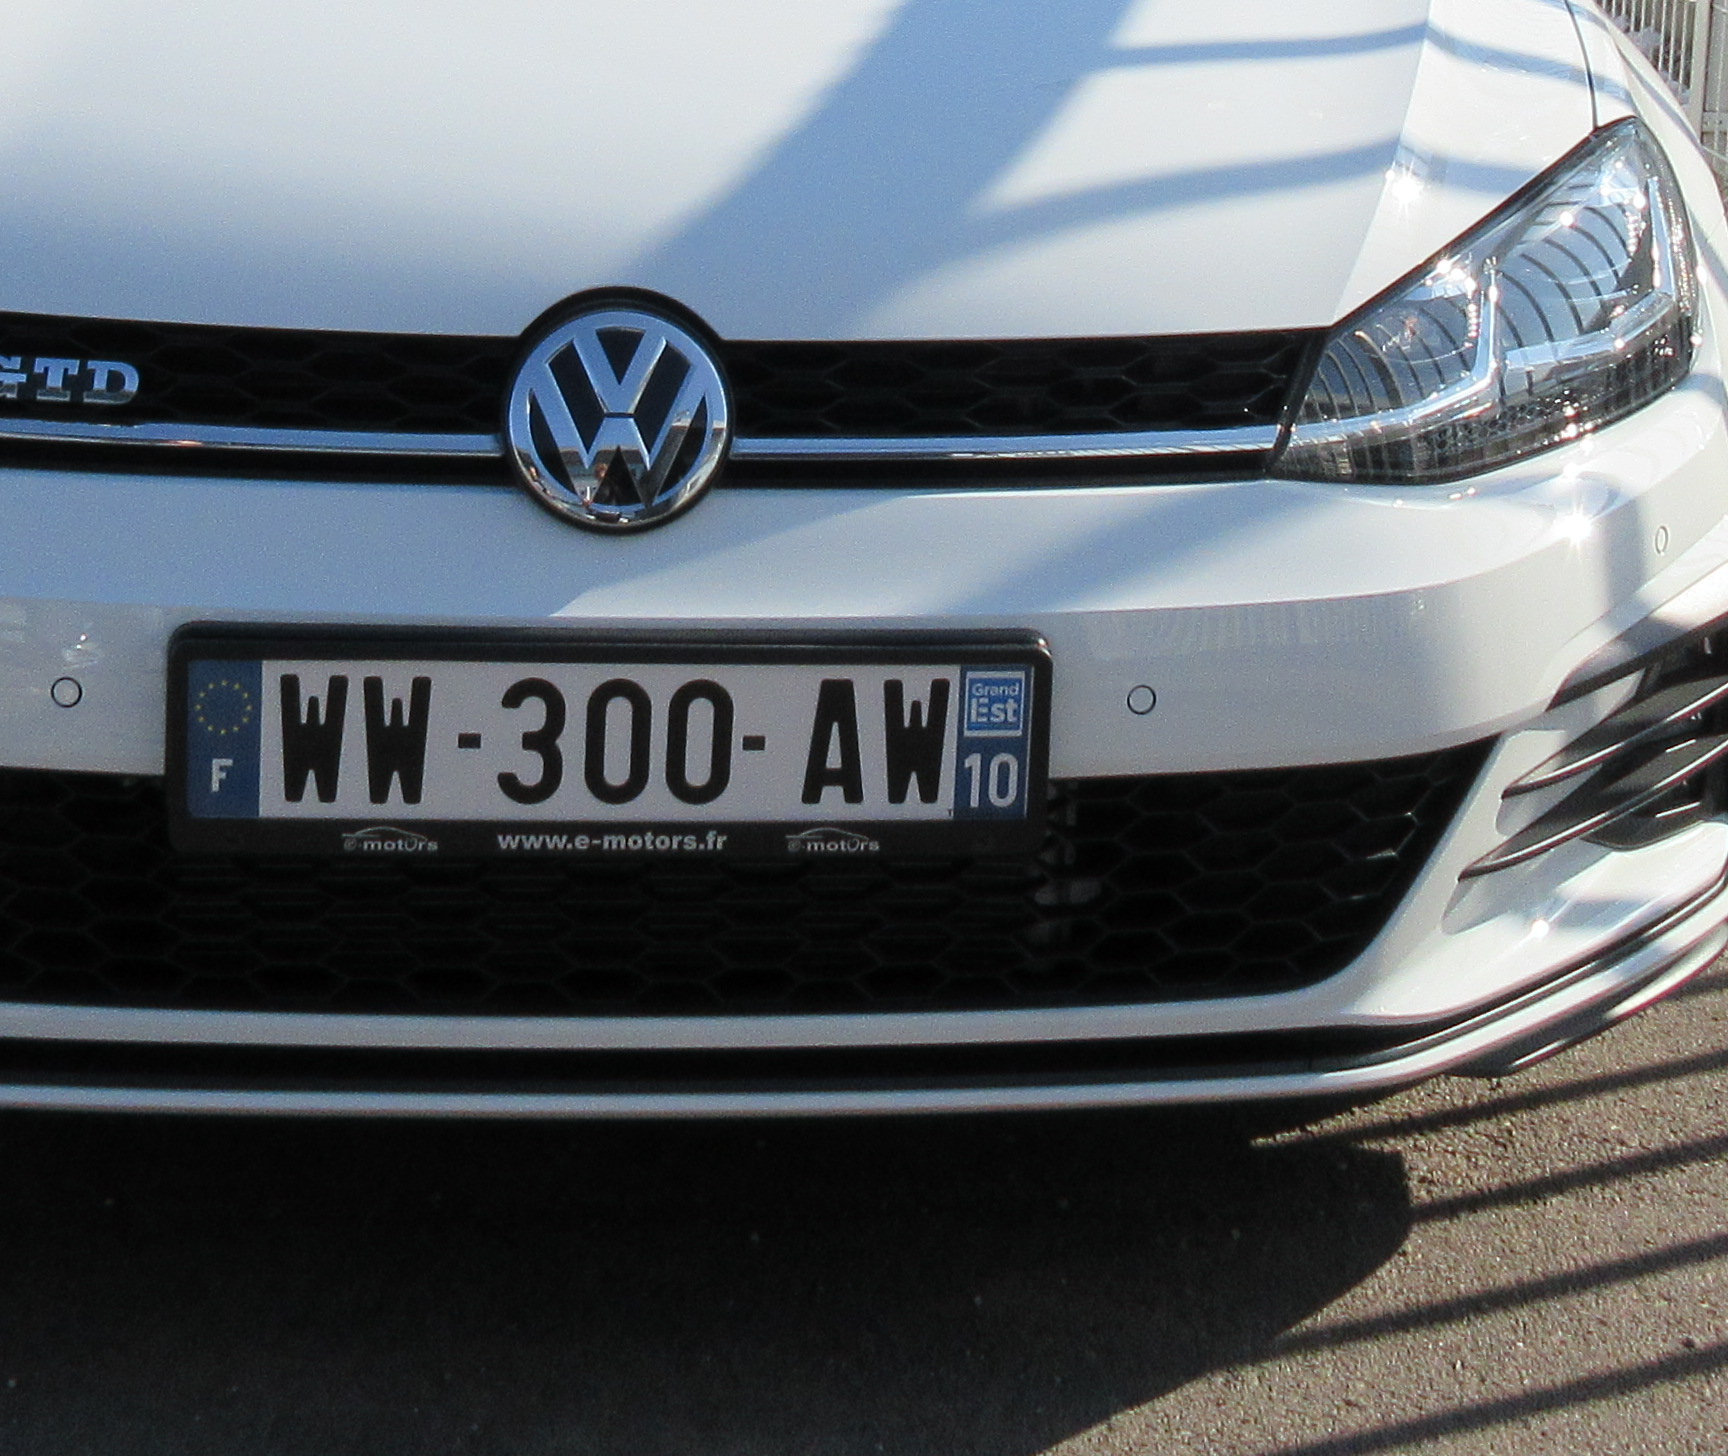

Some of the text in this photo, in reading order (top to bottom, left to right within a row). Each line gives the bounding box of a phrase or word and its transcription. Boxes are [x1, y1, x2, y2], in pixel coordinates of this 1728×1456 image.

[972, 683, 1020, 696] Grand
[970, 697, 1018, 723] Est
[279, 673, 951, 805] WW-300-AW
[210, 758, 234, 793] F
[964, 752, 1019, 808] 10
[496, 830, 728, 851] www.e-motors.fr
